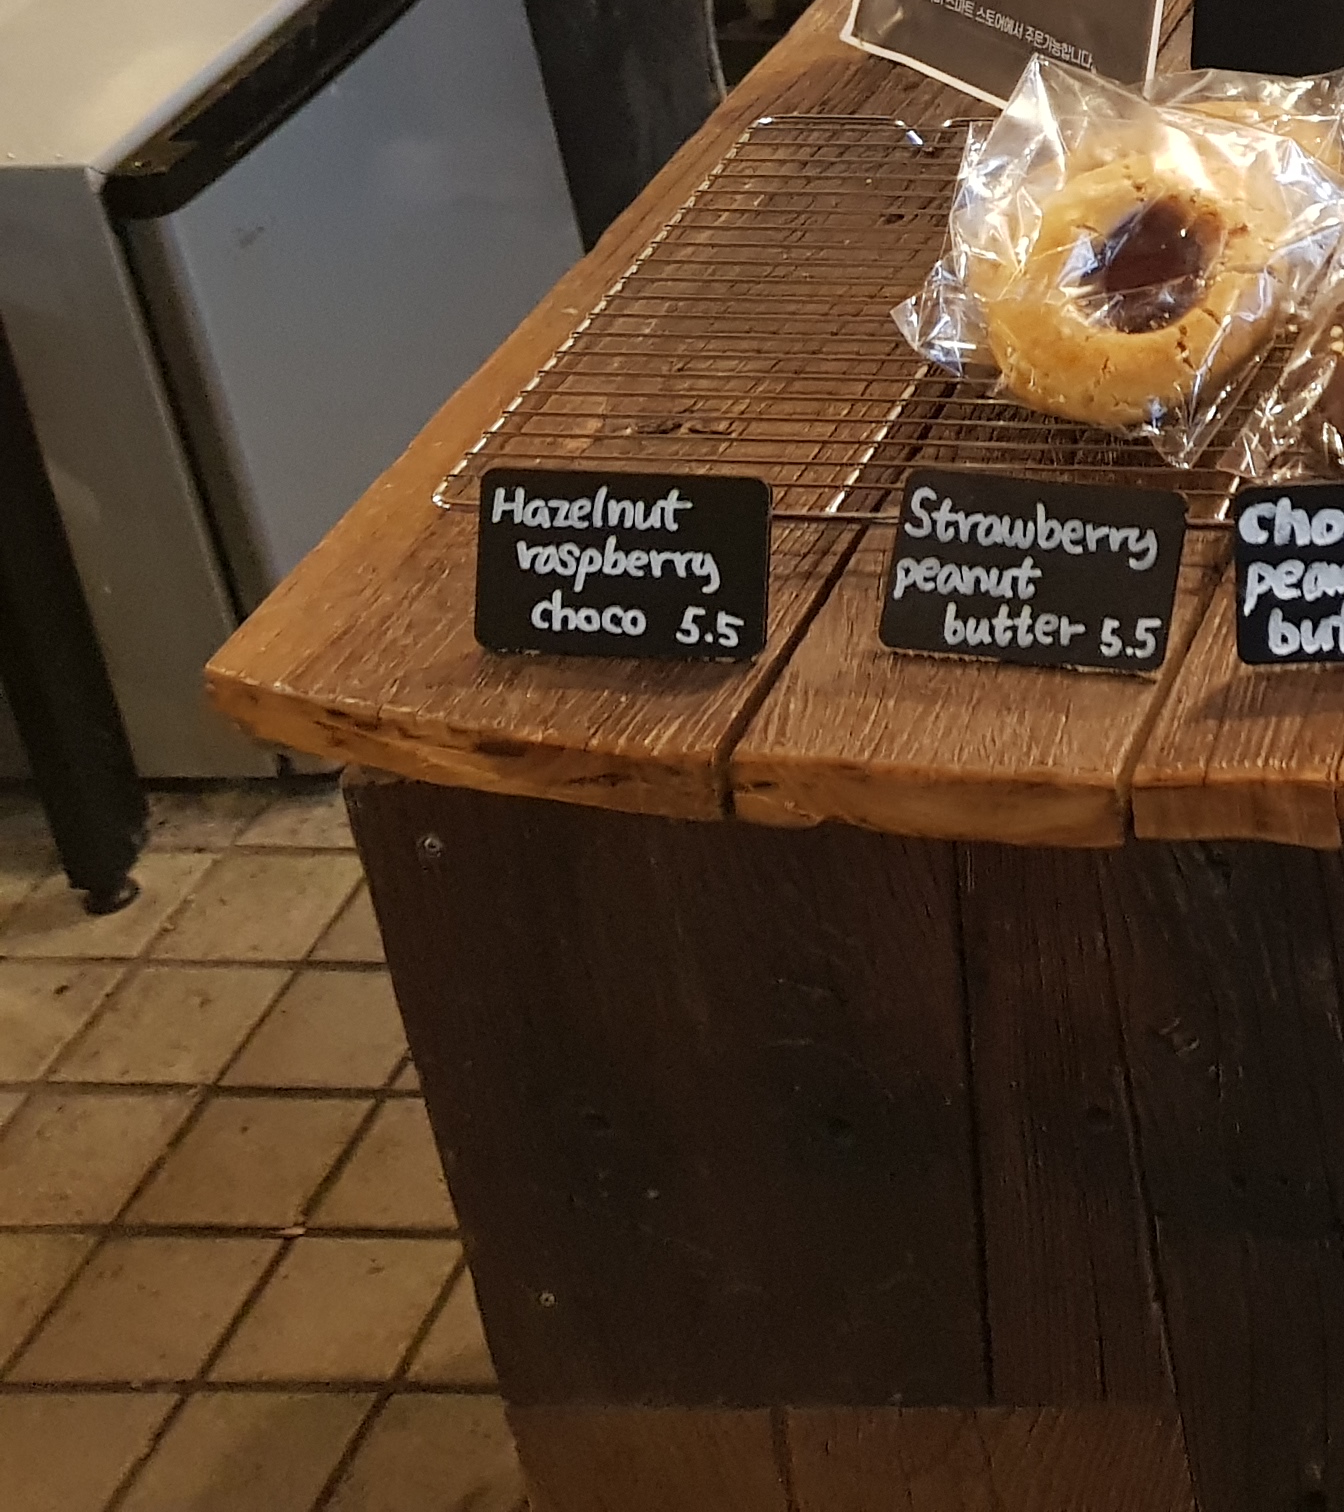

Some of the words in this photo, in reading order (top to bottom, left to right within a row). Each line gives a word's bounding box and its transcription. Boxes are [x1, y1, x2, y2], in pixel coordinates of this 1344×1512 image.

[975, 6, 1024, 40] 스토어에서
[492, 486, 693, 531] Hazelnut
[904, 486, 1158, 570] Strawberry
[516, 535, 720, 594] raspberry
[893, 556, 1042, 600] peanut
[531, 589, 646, 636] choco
[676, 606, 744, 647] 5.5
[943, 602, 1086, 648] butter
[1100, 617, 1161, 658] 5.5
